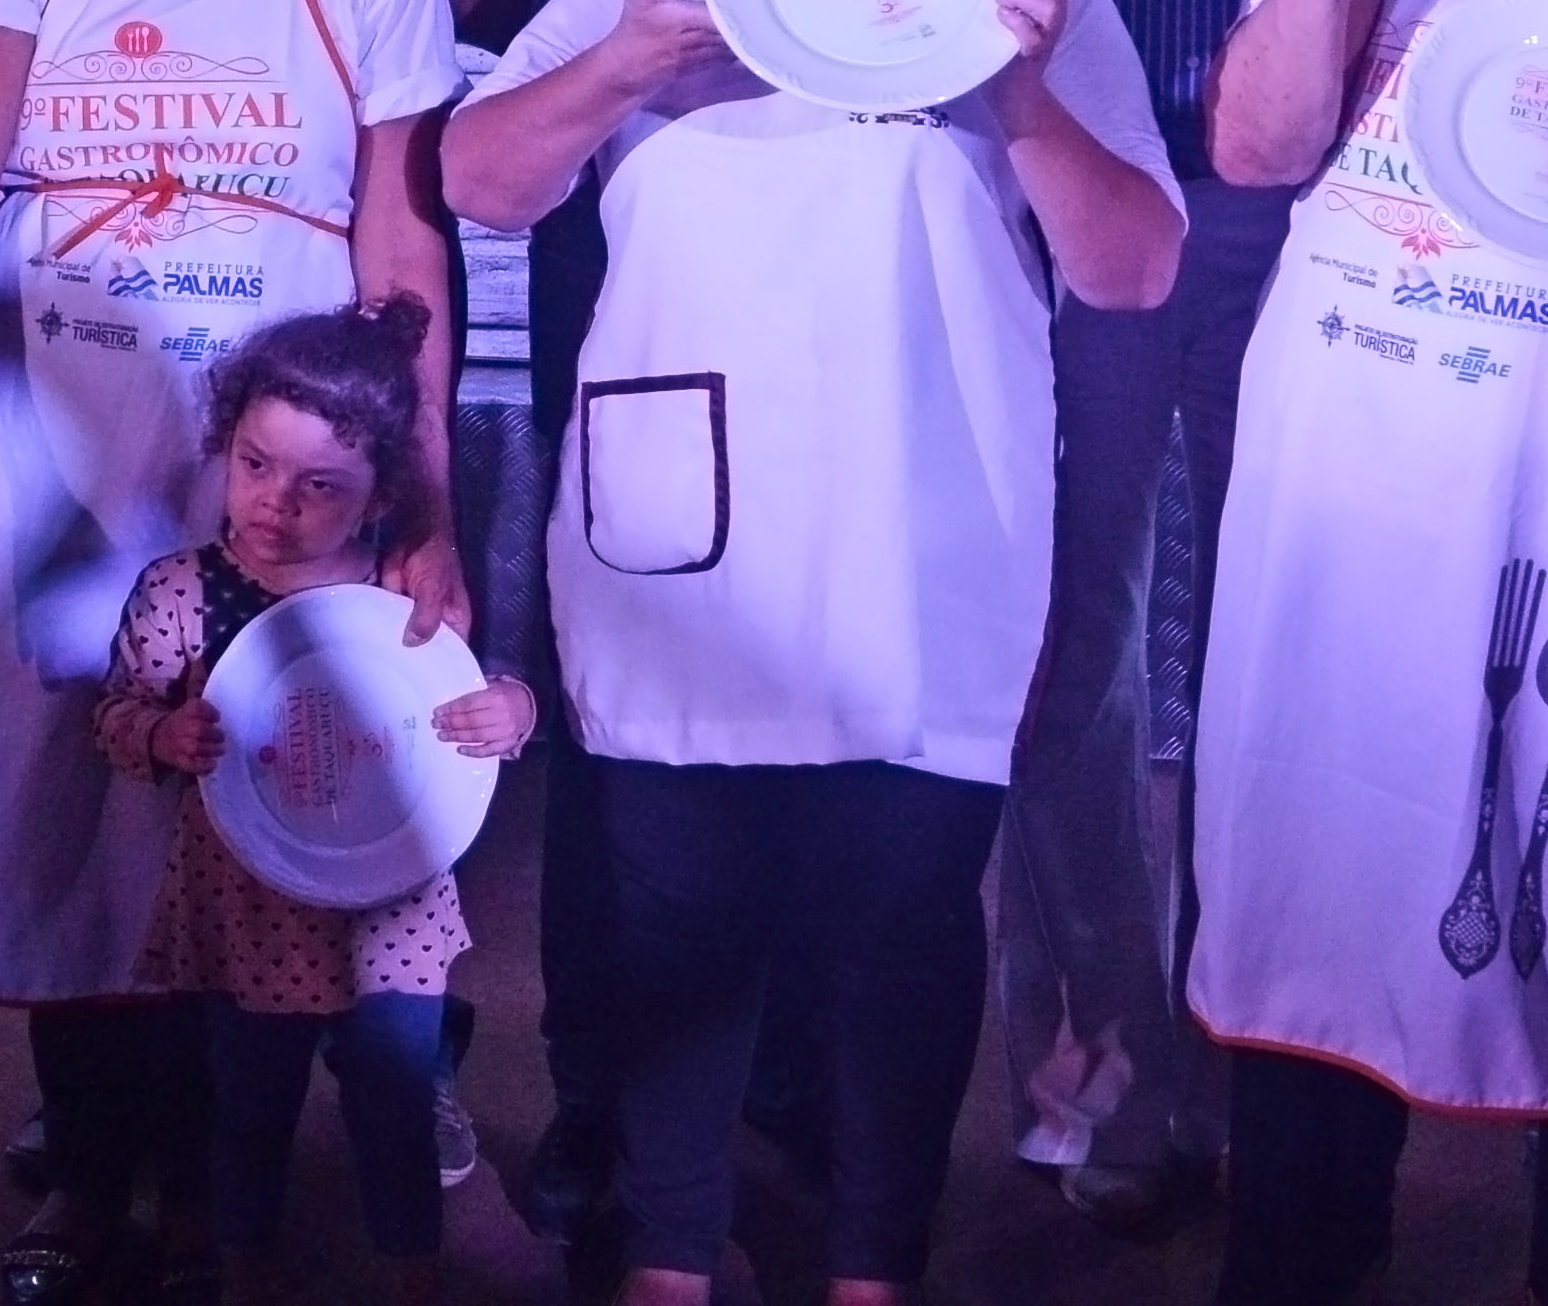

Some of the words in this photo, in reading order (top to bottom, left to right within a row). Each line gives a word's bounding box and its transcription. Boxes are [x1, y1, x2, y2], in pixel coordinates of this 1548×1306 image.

[20, 97, 46, 131] 9º
[49, 92, 303, 133] FESTIVAL
[1509, 105, 1531, 119] DE
[19, 135, 300, 172] GASTRONÔMICO
[56, 271, 90, 284] Turismo
[164, 261, 264, 275] PREFEITURA
[1343, 272, 1377, 288] Turismo
[163, 273, 263, 299] PALMAS
[72, 324, 138, 348] TURÍSTICA
[160, 336, 229, 352] SEBRAE
[1354, 331, 1415, 361] TURÍSTICA
[1438, 353, 1512, 378] SEBRAE
[286, 688, 307, 790] FESTIVAL
